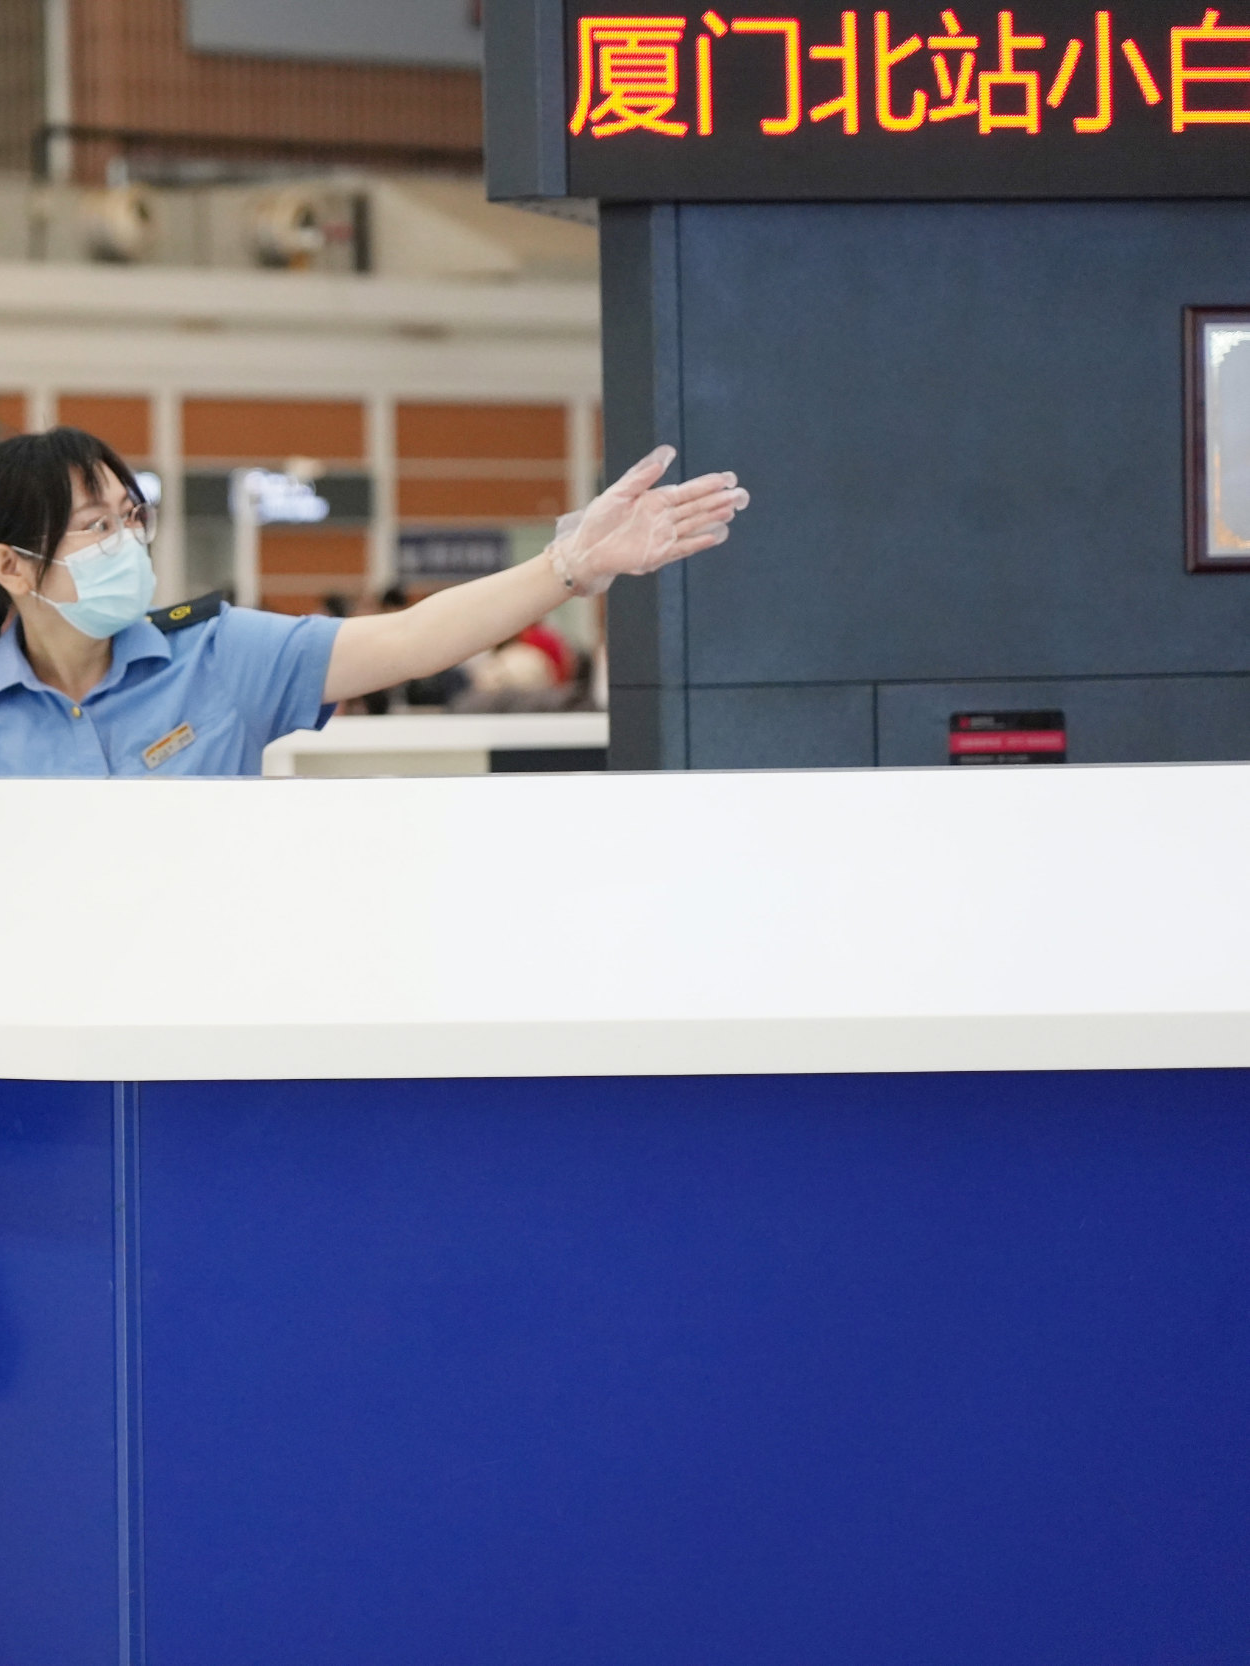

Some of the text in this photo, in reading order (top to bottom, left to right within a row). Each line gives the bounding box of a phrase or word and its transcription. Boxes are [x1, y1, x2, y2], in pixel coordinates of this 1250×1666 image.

[568, 8, 1250, 138] 厦门北站小白
